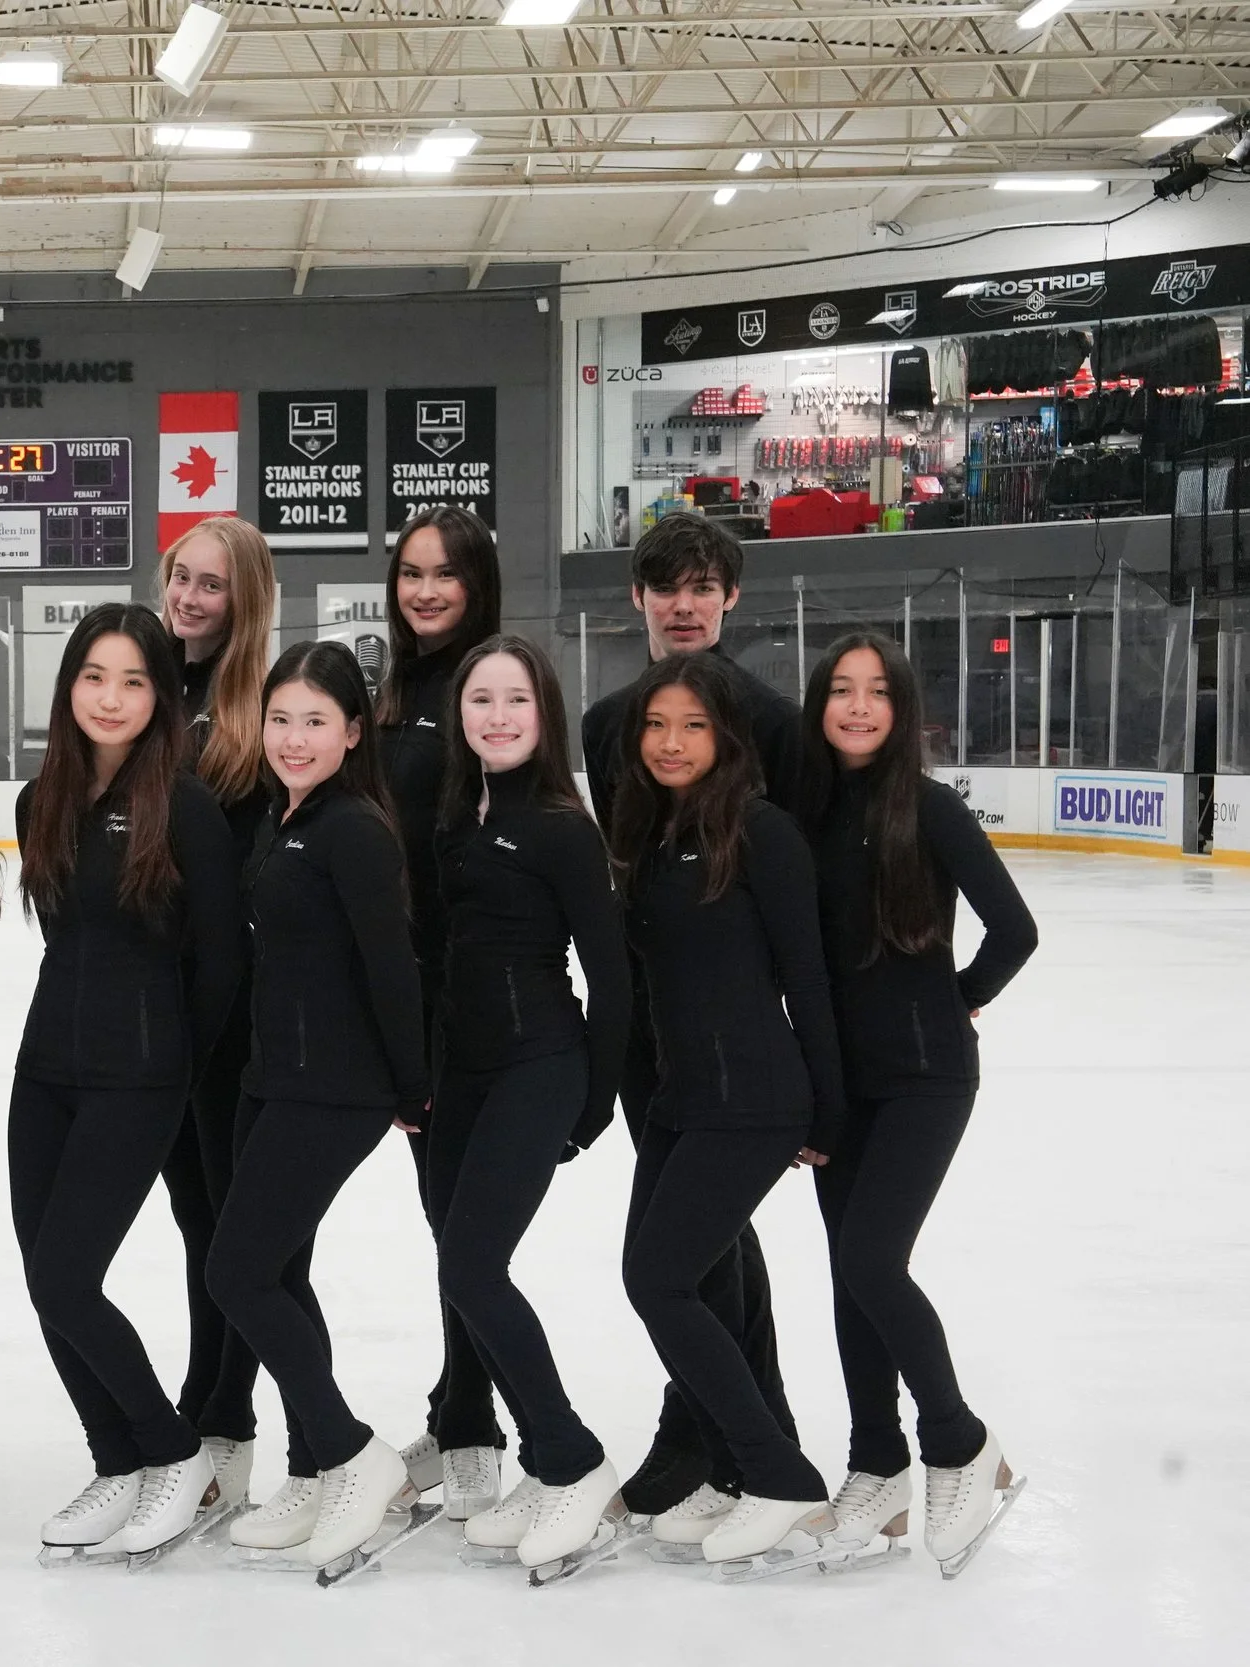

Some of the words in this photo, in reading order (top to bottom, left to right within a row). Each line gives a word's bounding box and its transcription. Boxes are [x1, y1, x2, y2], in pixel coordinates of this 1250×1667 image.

[1157, 269, 1212, 291] REIGN
[888, 295, 914, 310] LA
[742, 314, 762, 333] LA
[1013, 310, 1057, 322] HOCKEY
[293, 409, 333, 426] LA
[421, 407, 461, 424] LA
[67, 443, 120, 457] VISITOR
[265, 466, 327, 480] STANLEY
[332, 465, 361, 479] CUP
[393, 464, 455, 478] STANLEY
[460, 463, 489, 477] CUP
[73, 490, 101, 498] PENALTY
[265, 481, 361, 498] CHAMPIONS
[393, 479, 490, 496] CHAMPIONS
[47, 507, 79, 516] PLAYER
[91, 506, 128, 516] PENALTY
[280, 505, 347, 524] 2011-12
[19, 527, 36, 535] Inn
[44, 605, 96, 624] BLA
[334, 601, 388, 621] MILL
[1060, 787, 1112, 822] BUD
[1114, 789, 1165, 828] LIGHT
